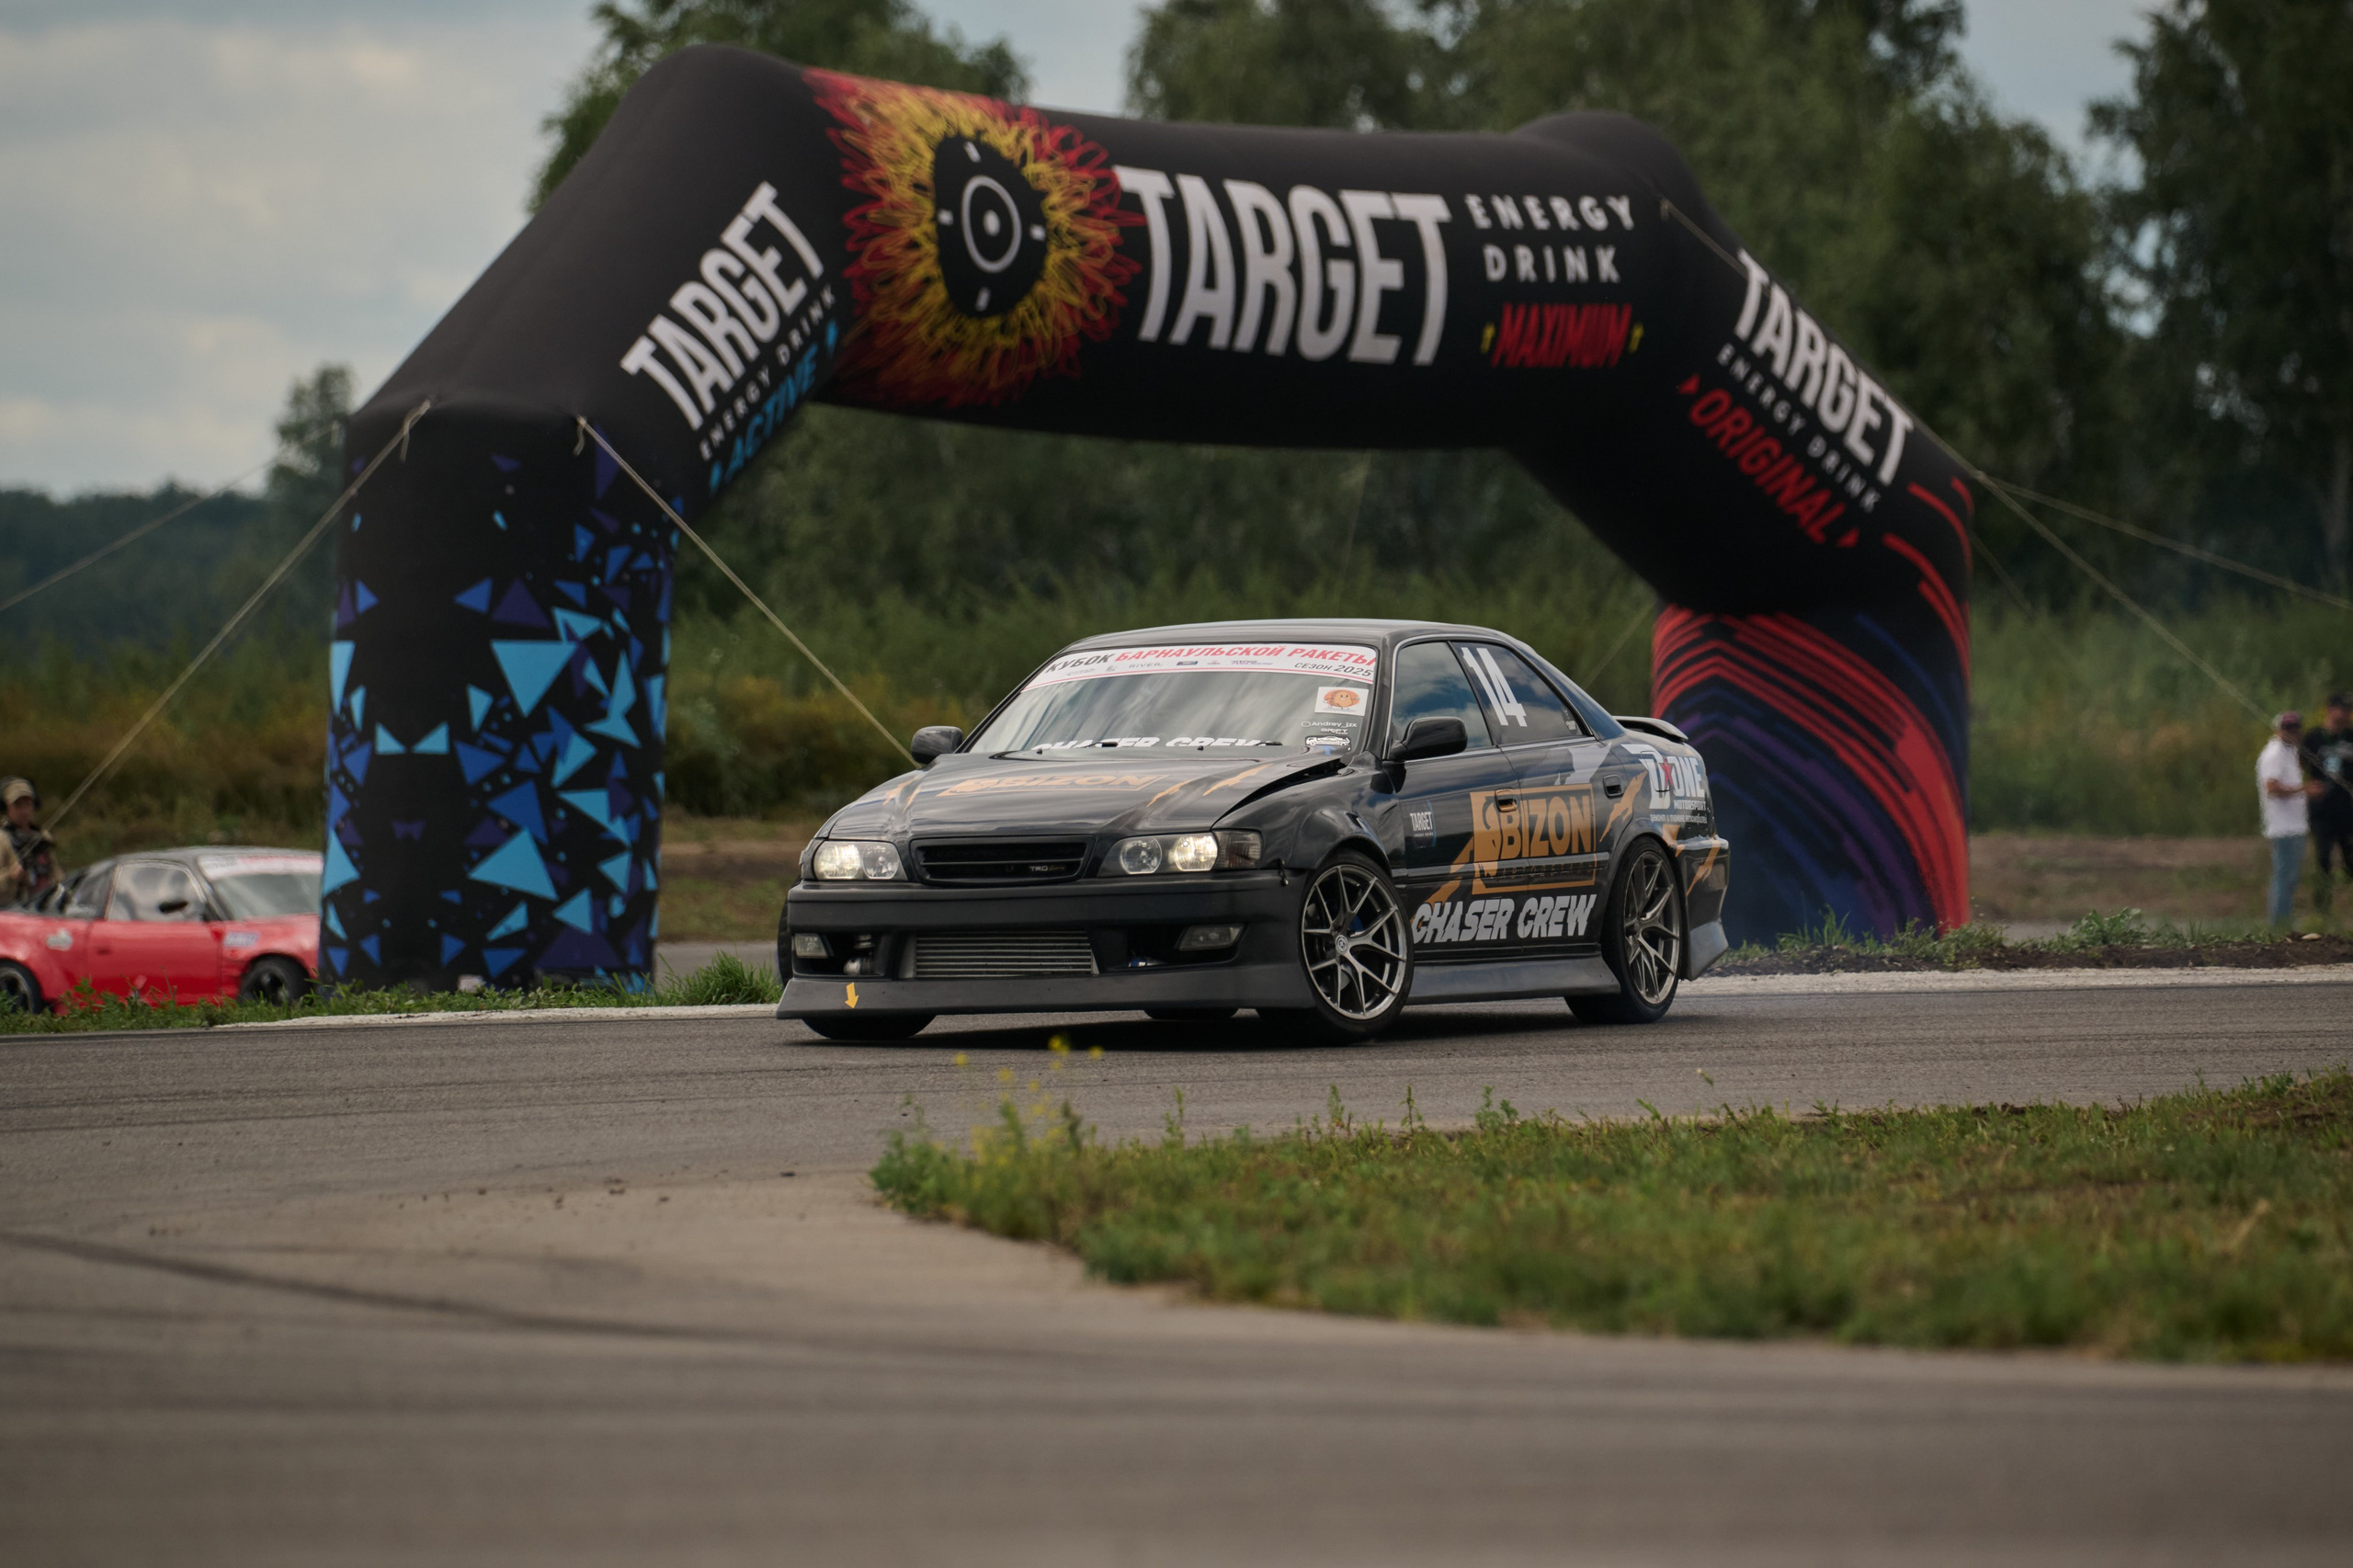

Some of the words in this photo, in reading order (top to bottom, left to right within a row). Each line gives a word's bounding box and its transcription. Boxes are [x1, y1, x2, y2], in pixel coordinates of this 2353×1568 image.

[1464, 194, 1635, 231] ENERGY
[1112, 165, 1452, 366] TARGET
[1482, 244, 1621, 284] DRINK
[620, 181, 824, 430] TARGET
[1490, 301, 1632, 369] MAXIMUM
[699, 365, 770, 460] ENERGY
[775, 284, 835, 367] DRINK
[1734, 247, 1914, 487] TARGET
[1716, 343, 1807, 437] ENERGY
[1806, 434, 1881, 513] DRINK
[1688, 388, 1846, 544] ORIGINAL
[1045, 653, 1115, 674] КУБОК
[1114, 645, 1287, 662] БАРНАУЛЬСКОЙ
[1287, 648, 1376, 666] РАКЕТЫ
[1294, 662, 1333, 671] СЕЗОН
[1334, 665, 1374, 676] 2025
[1460, 647, 1528, 727] 14
[1409, 811, 1433, 831] TARGET
[1499, 795, 1591, 859] BIZON
[1674, 799, 1707, 811] MOTORSPORT
[1410, 898, 1515, 945] CHASER
[1518, 894, 1597, 939] CREW
